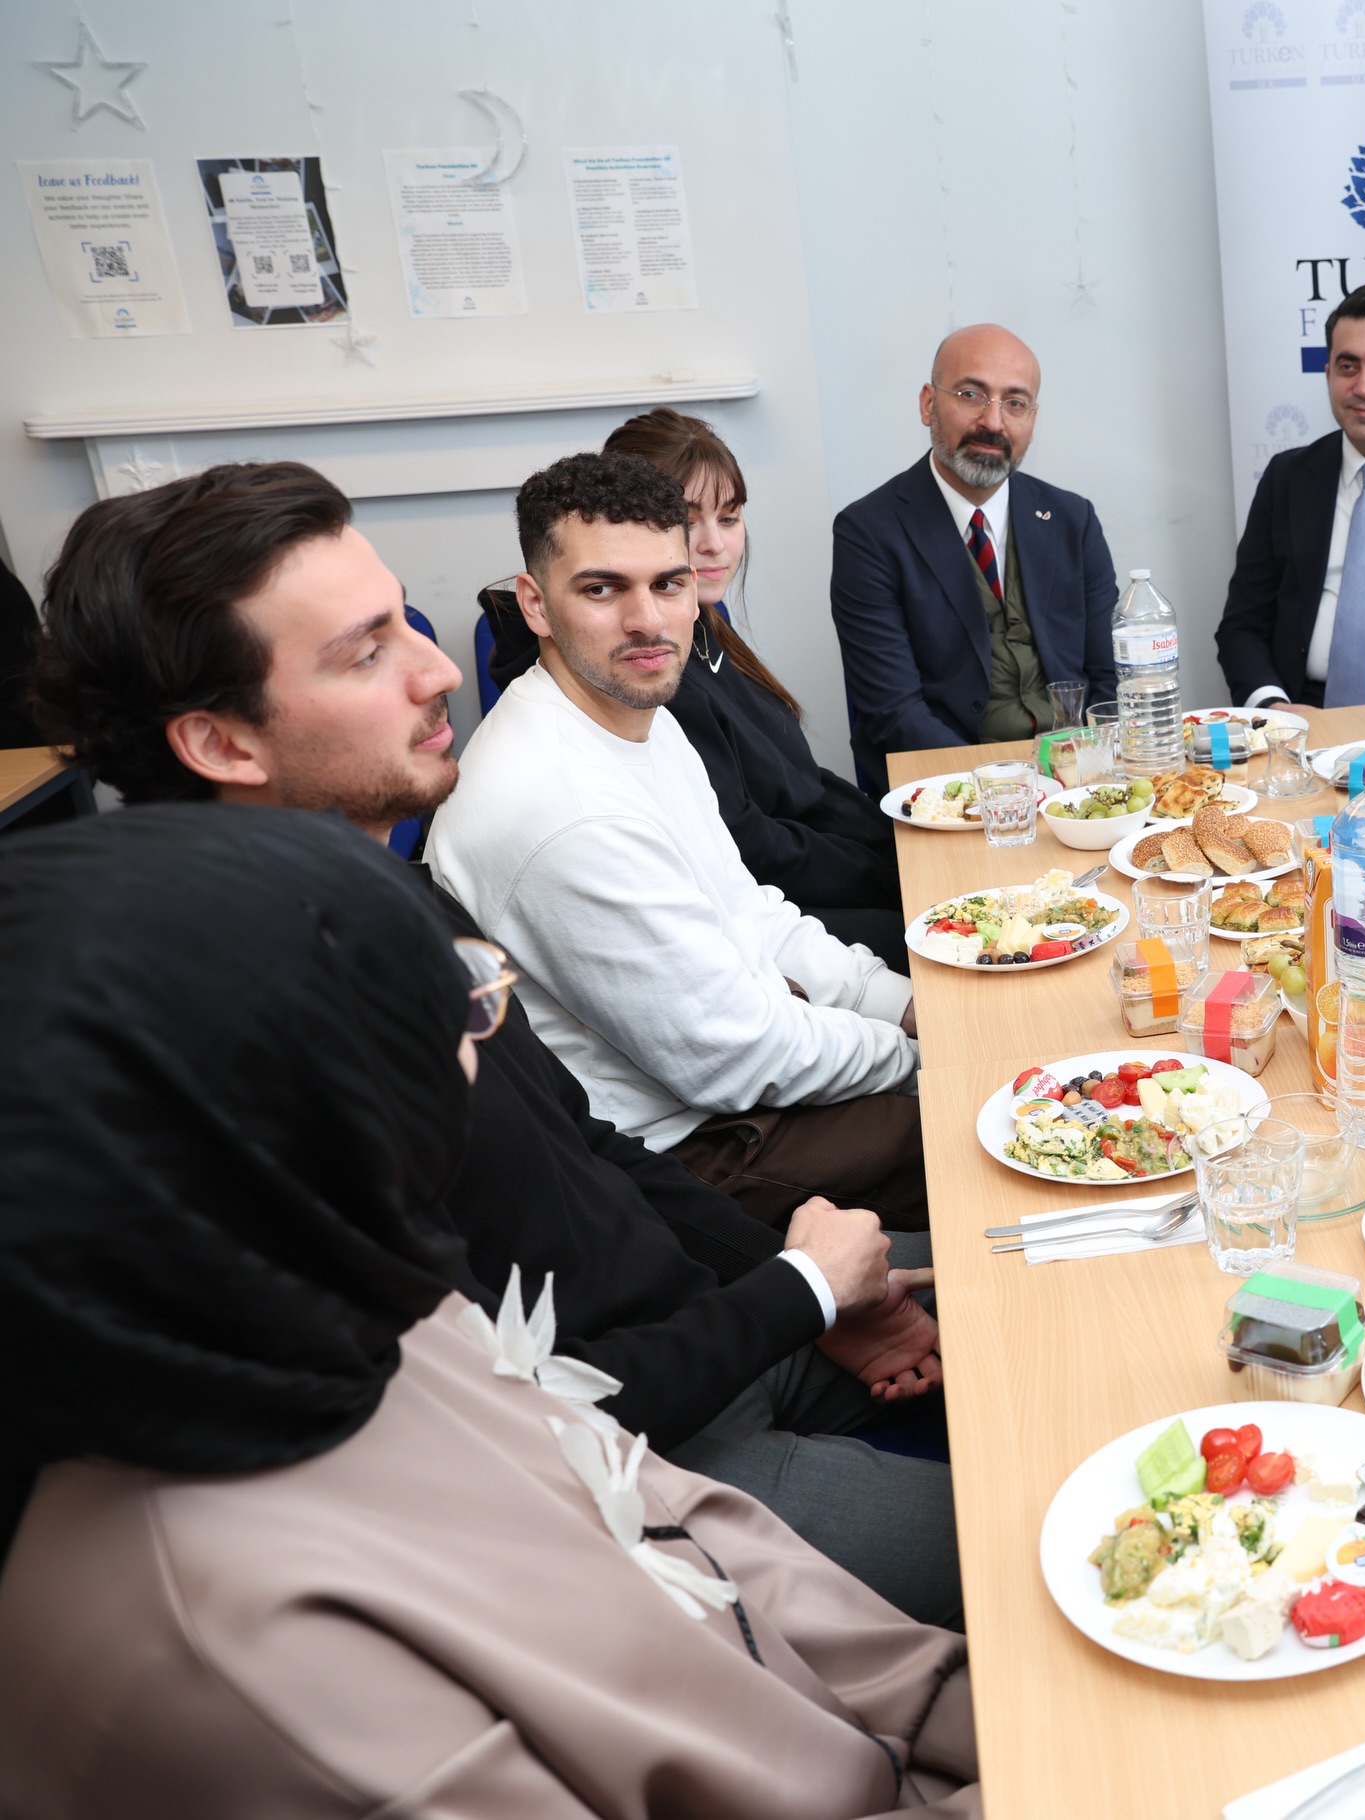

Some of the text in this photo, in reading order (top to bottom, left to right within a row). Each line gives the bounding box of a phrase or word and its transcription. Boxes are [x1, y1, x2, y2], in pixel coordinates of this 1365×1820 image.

[38, 173, 140, 188] Leave us Feedback!
